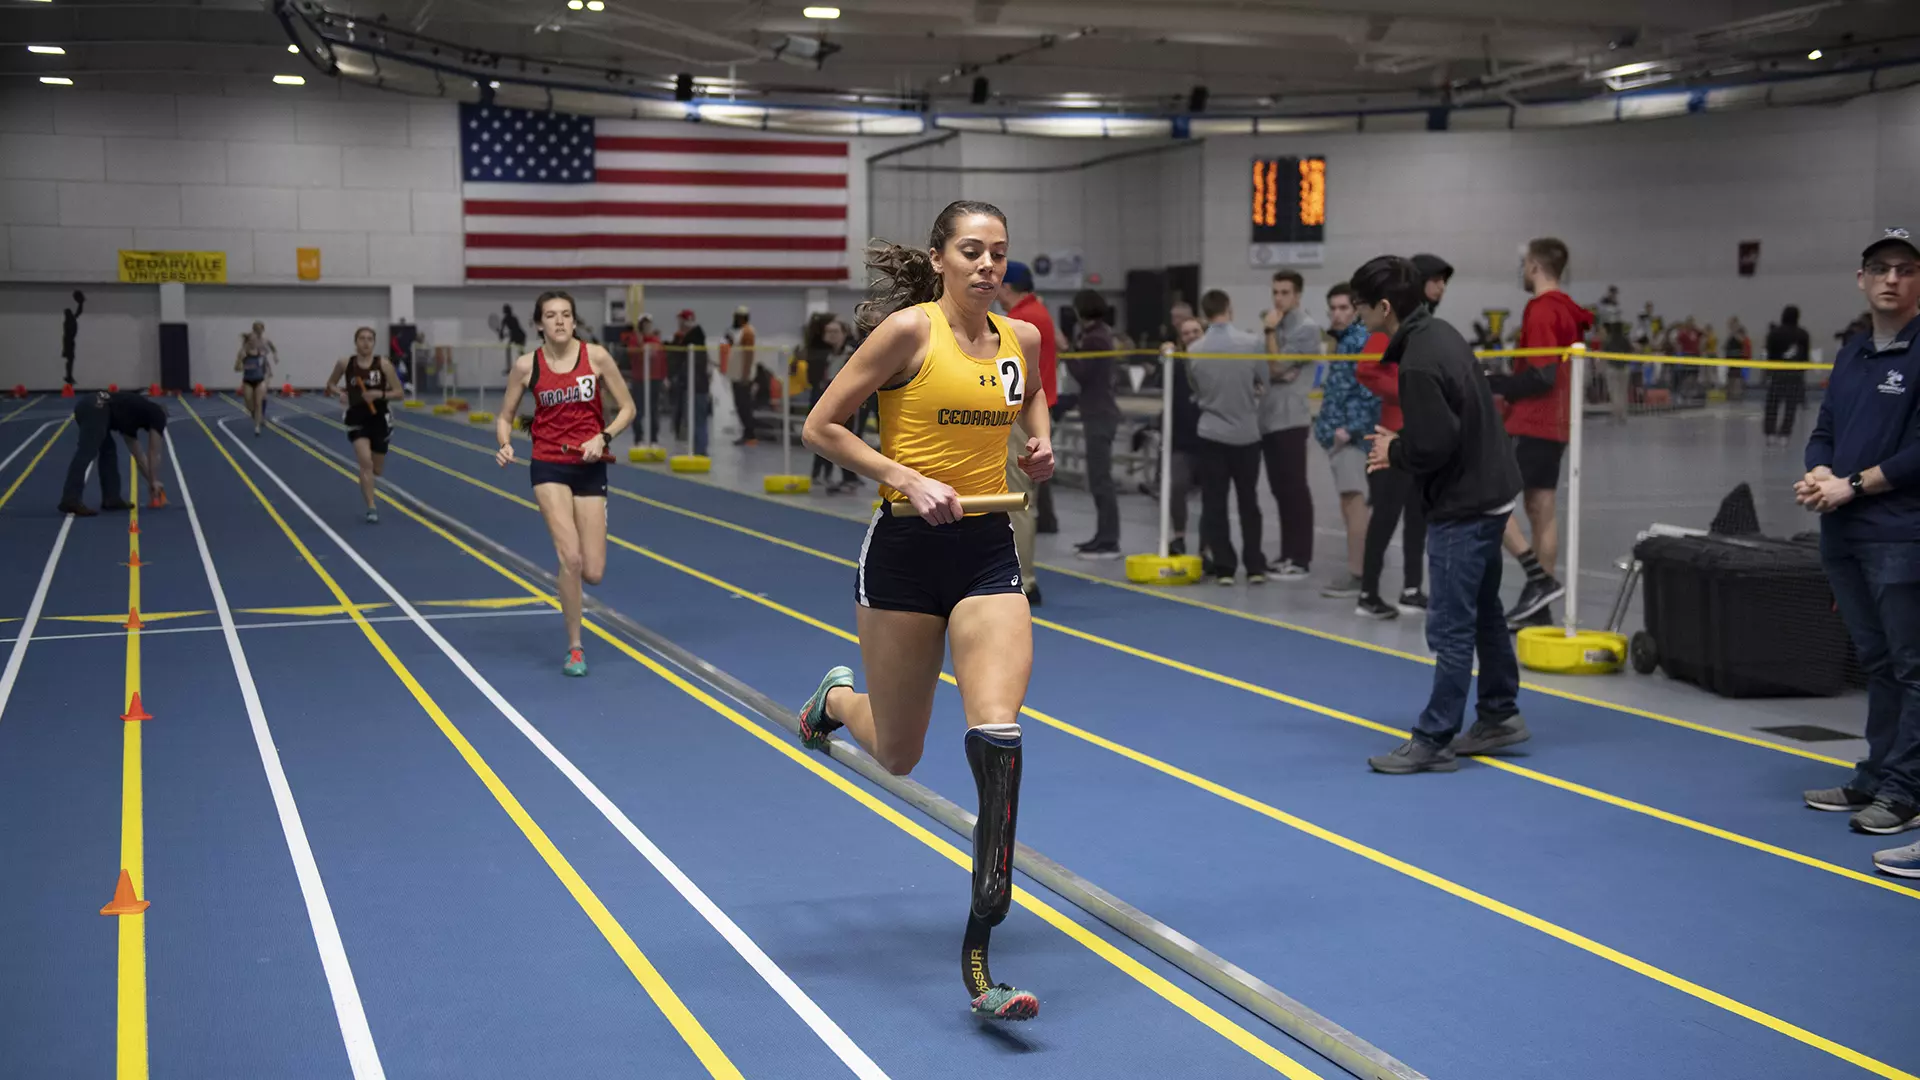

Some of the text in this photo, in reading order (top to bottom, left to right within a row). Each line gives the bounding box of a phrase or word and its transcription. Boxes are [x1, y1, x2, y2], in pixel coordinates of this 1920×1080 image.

[123, 257, 222, 271] CEDARVILLE
[582, 378, 593, 398] 3
[1001, 361, 1022, 401] 2
[937, 408, 1021, 426] CEDARVILL
